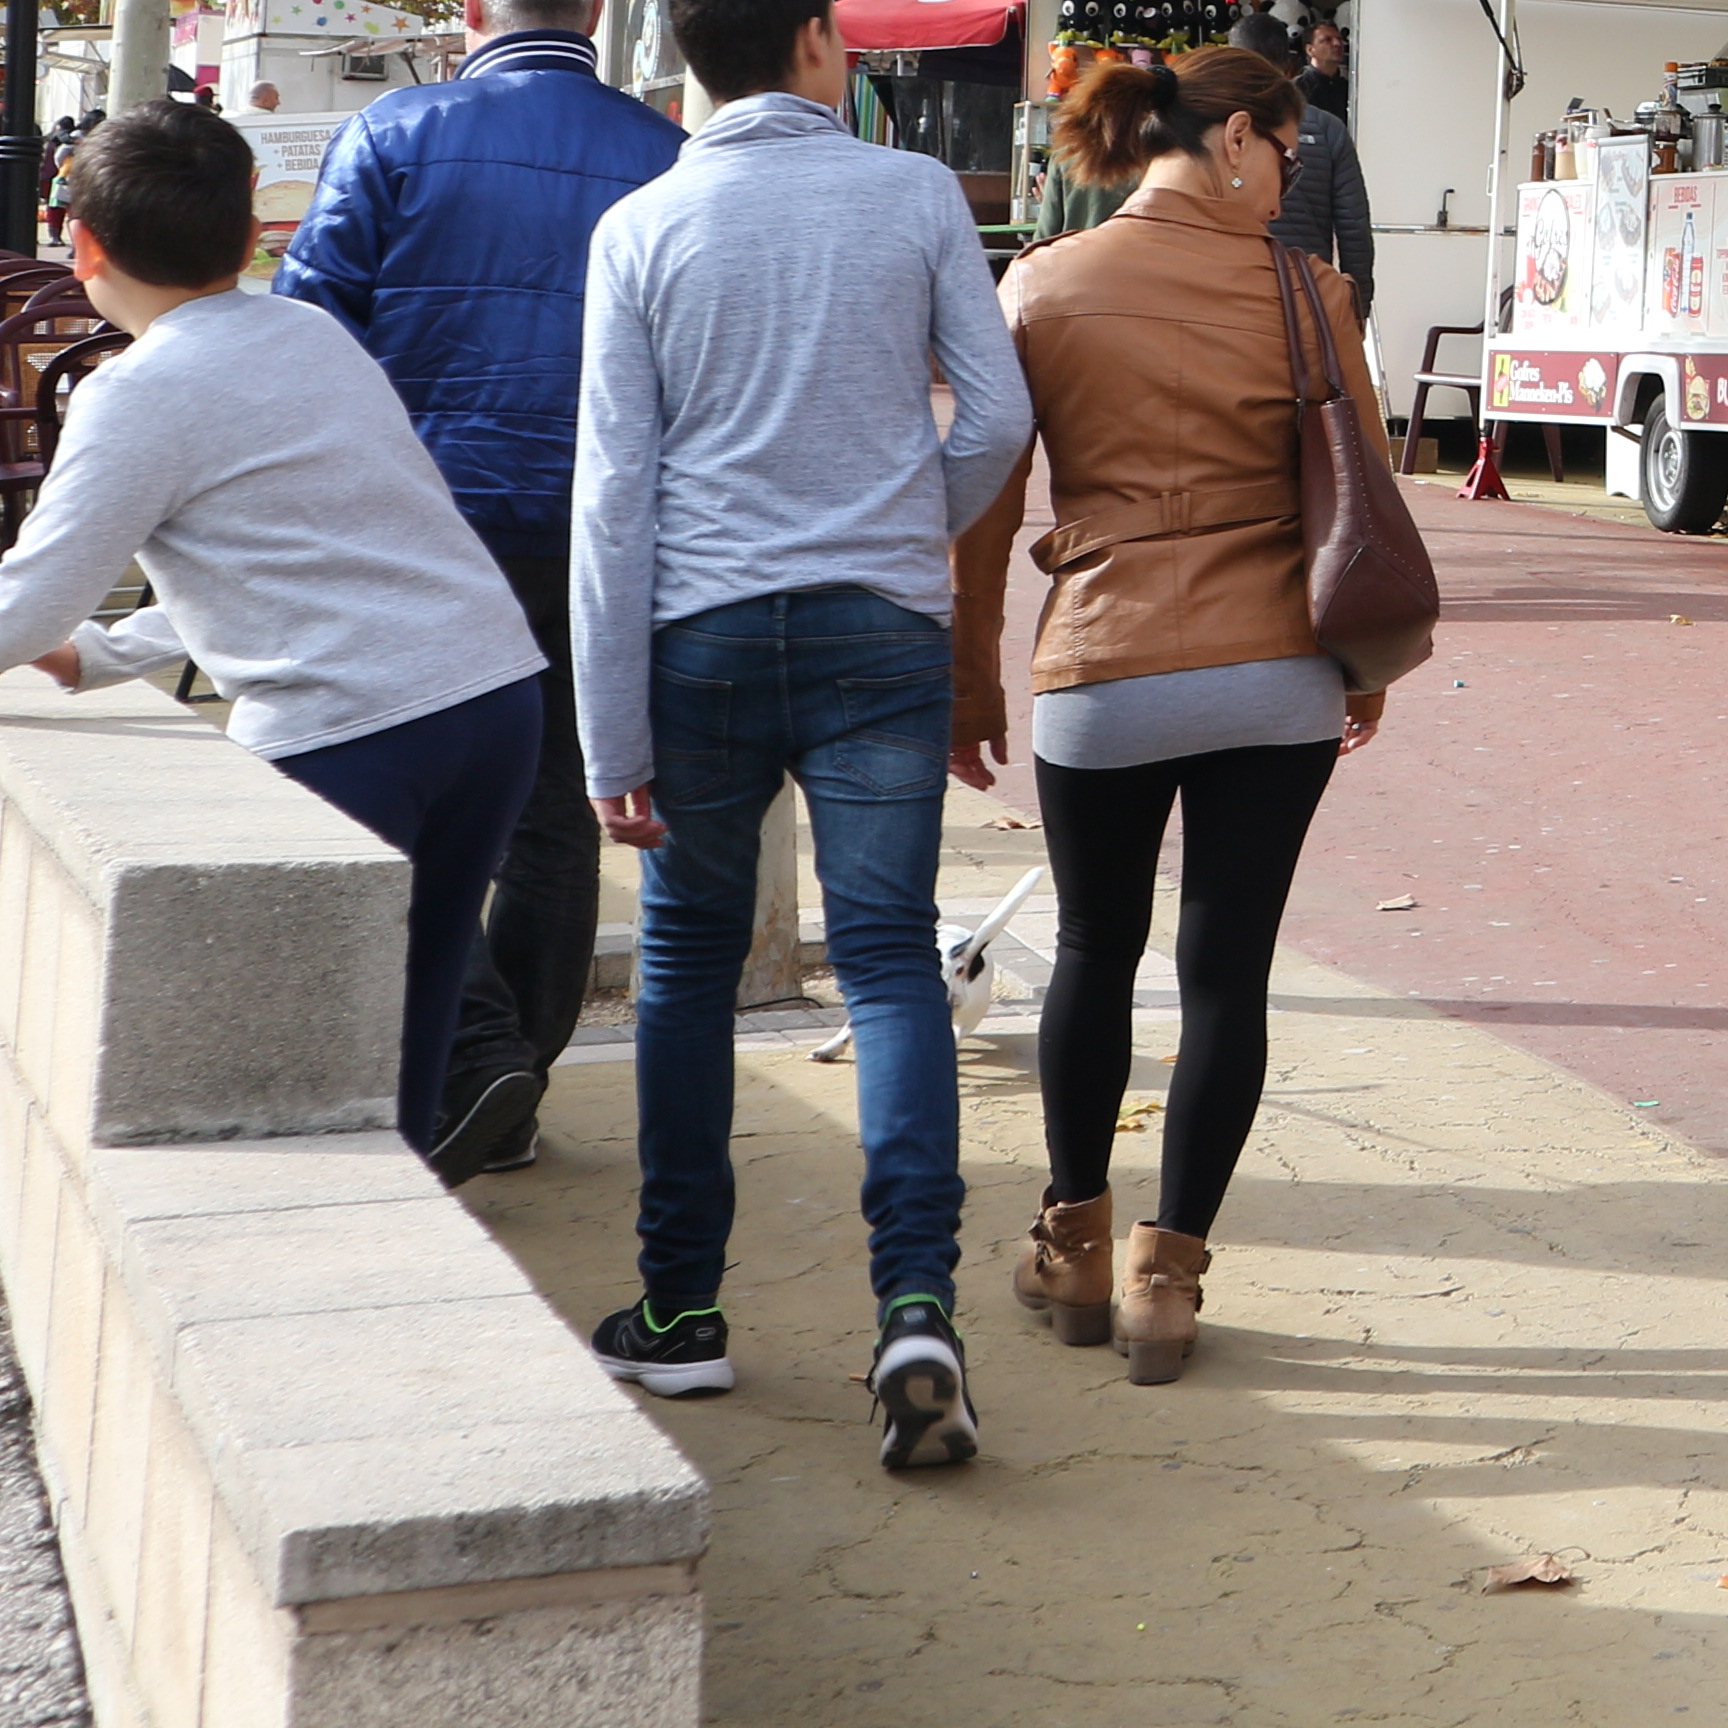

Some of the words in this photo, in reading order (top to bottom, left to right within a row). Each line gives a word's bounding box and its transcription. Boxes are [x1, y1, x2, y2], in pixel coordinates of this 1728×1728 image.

[260, 130, 331, 144] HAMBURGUESA
[281, 144, 321, 158] PATATAS
[285, 158, 319, 171] BEBIDA
[1510, 360, 1541, 382] Gofres
[1508, 379, 1576, 405] Manneken-Pis
